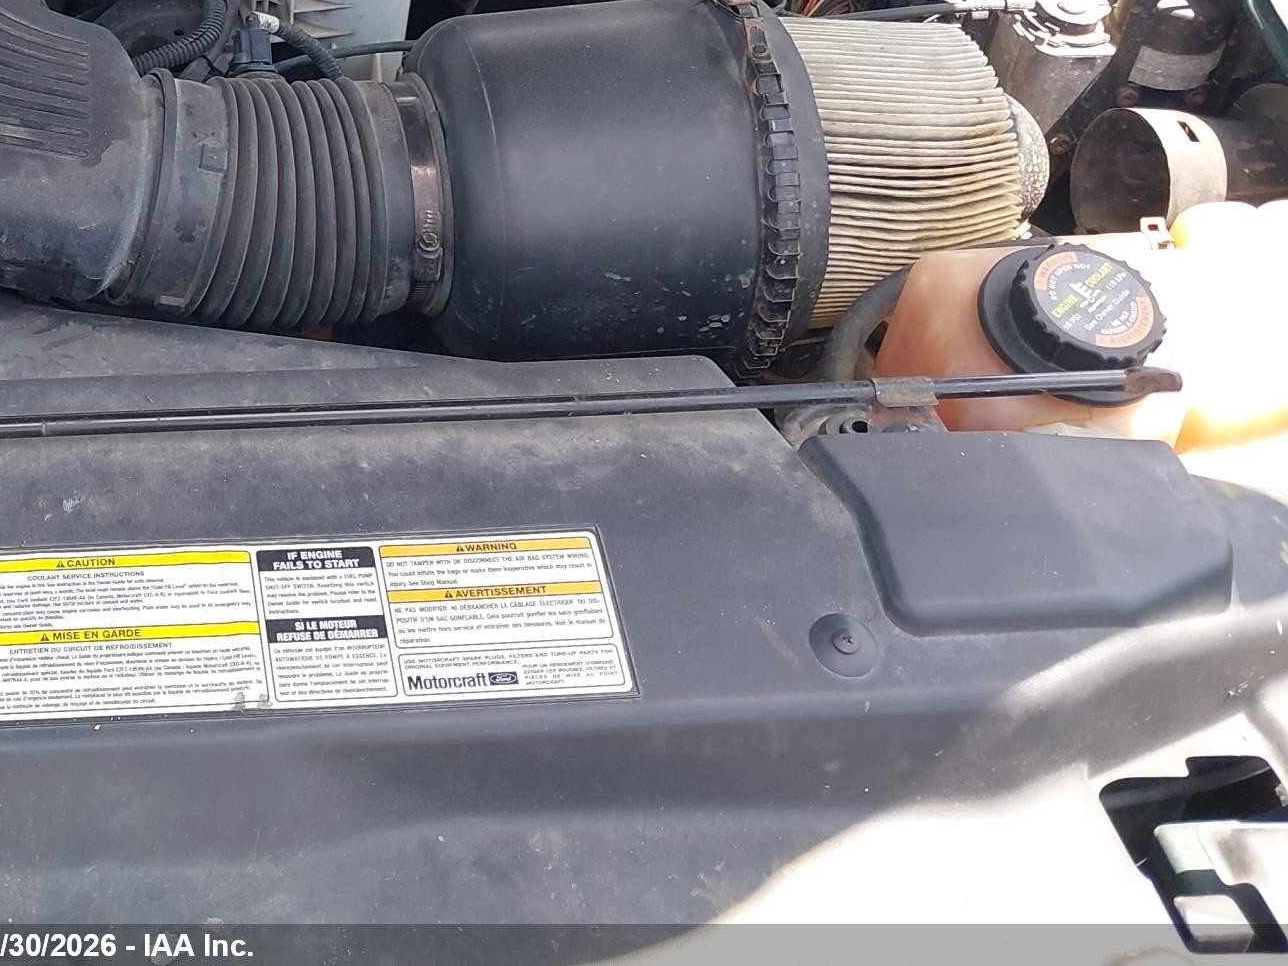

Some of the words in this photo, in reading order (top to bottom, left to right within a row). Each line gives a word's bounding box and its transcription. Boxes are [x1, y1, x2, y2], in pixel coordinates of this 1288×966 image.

[1051, 294, 1079, 318] ENGINE
[1085, 262, 1112, 288] COOLANT
[465, 542, 517, 552] WARNING
[287, 552, 297, 560] IF
[300, 550, 342, 560] ENGINE
[66, 557, 116, 568] CAUTION
[273, 561, 304, 570] FAILS
[306, 560, 322, 569] TO
[325, 559, 359, 568] START
[455, 586, 547, 598] AVERTISSEMENT
[295, 622, 304, 630] SI
[307, 621, 317, 630] LE
[319, 620, 357, 629] MOTEUR
[53, 632, 80, 641] MISE
[84, 630, 99, 639] EN
[102, 629, 141, 638] GARDE
[276, 633, 312, 642] REFUSE
[313, 632, 326, 640] DE
[328, 628, 378, 639] DÉMARRER
[106, 642, 172, 650] REFROIDISSEMENT
[408, 673, 488, 690] Motorcraft
